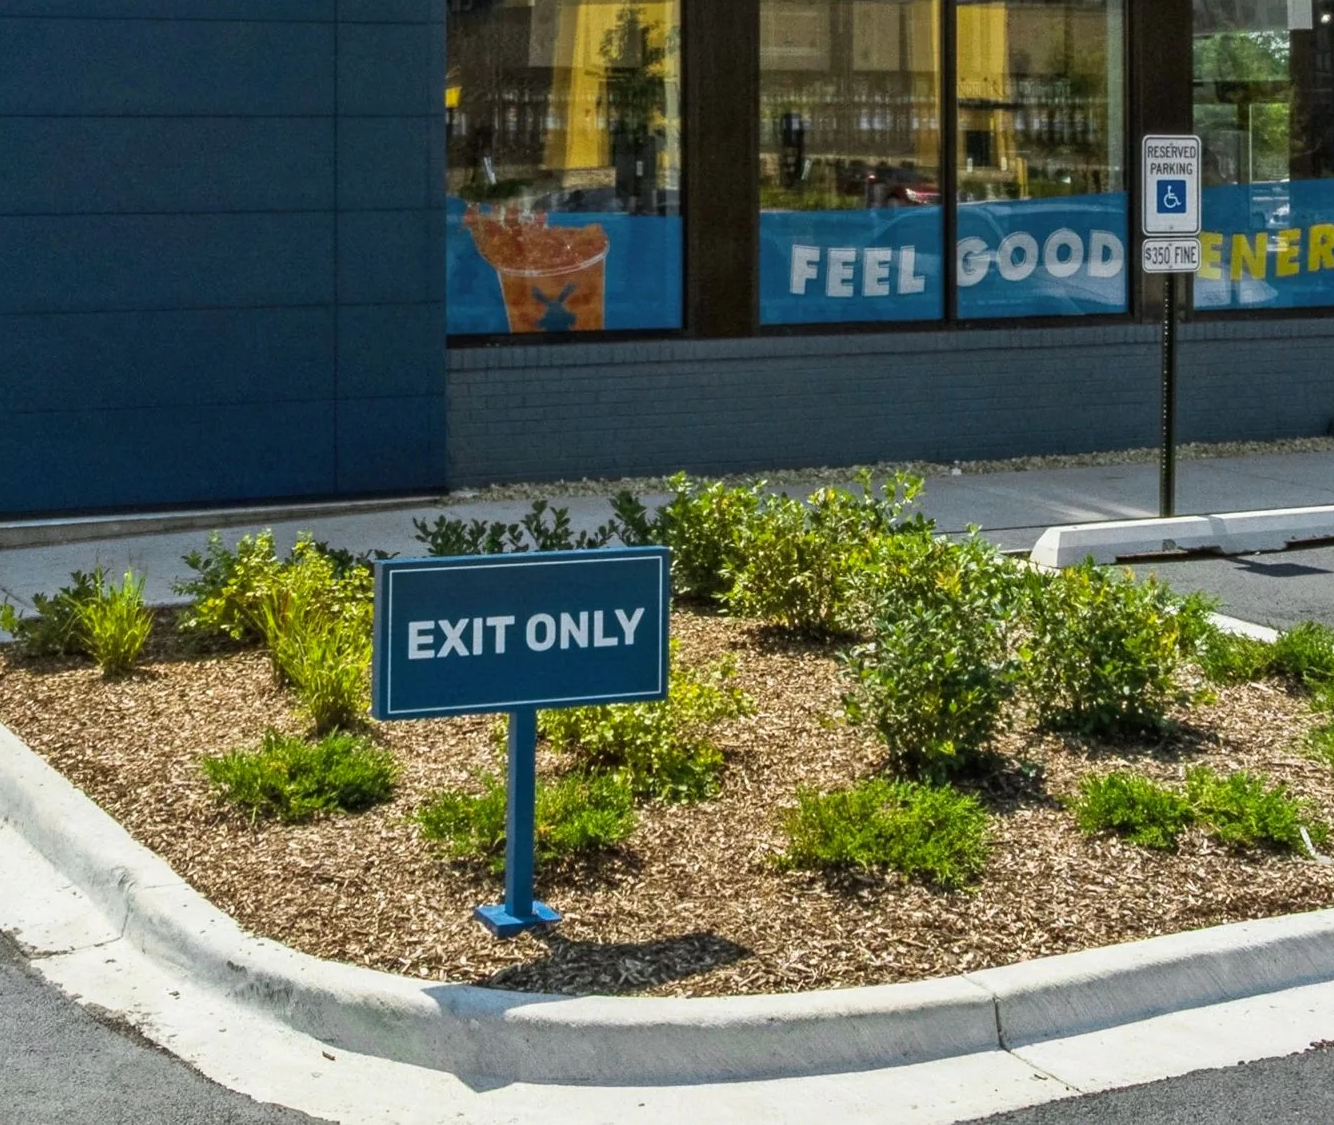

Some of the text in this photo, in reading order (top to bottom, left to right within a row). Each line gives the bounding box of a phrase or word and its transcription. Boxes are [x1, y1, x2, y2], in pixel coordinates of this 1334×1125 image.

[1147, 145, 1197, 159] RESERVED
[1150, 162, 1193, 176] PARKING
[789, 244, 926, 298] FEEL
[956, 227, 1125, 287] GOOD
[1145, 246, 1197, 265] $350 FINE
[407, 607, 645, 660] EXIT ONLY
